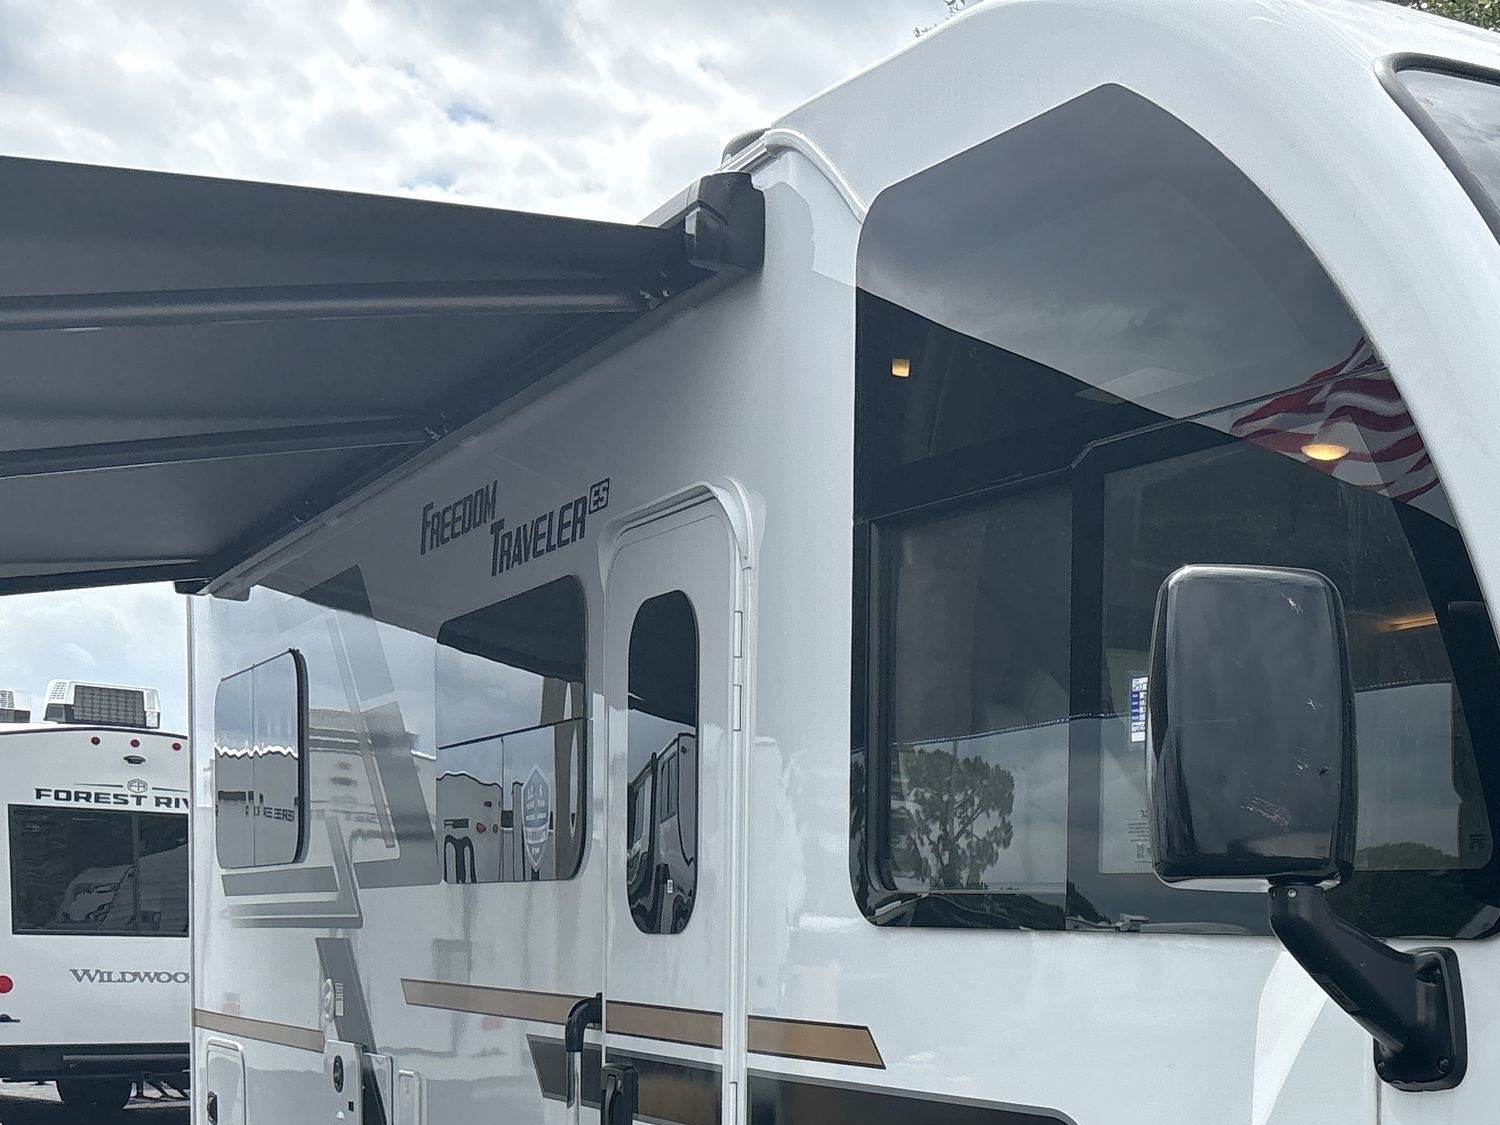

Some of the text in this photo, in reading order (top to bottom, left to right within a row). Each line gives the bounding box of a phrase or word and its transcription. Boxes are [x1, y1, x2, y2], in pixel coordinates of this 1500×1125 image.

[420, 480, 498, 555] FREEDOM
[490, 495, 588, 576] TRAVELER
[35, 787, 147, 806] FOREST
[69, 968, 189, 984] WILDWOO
